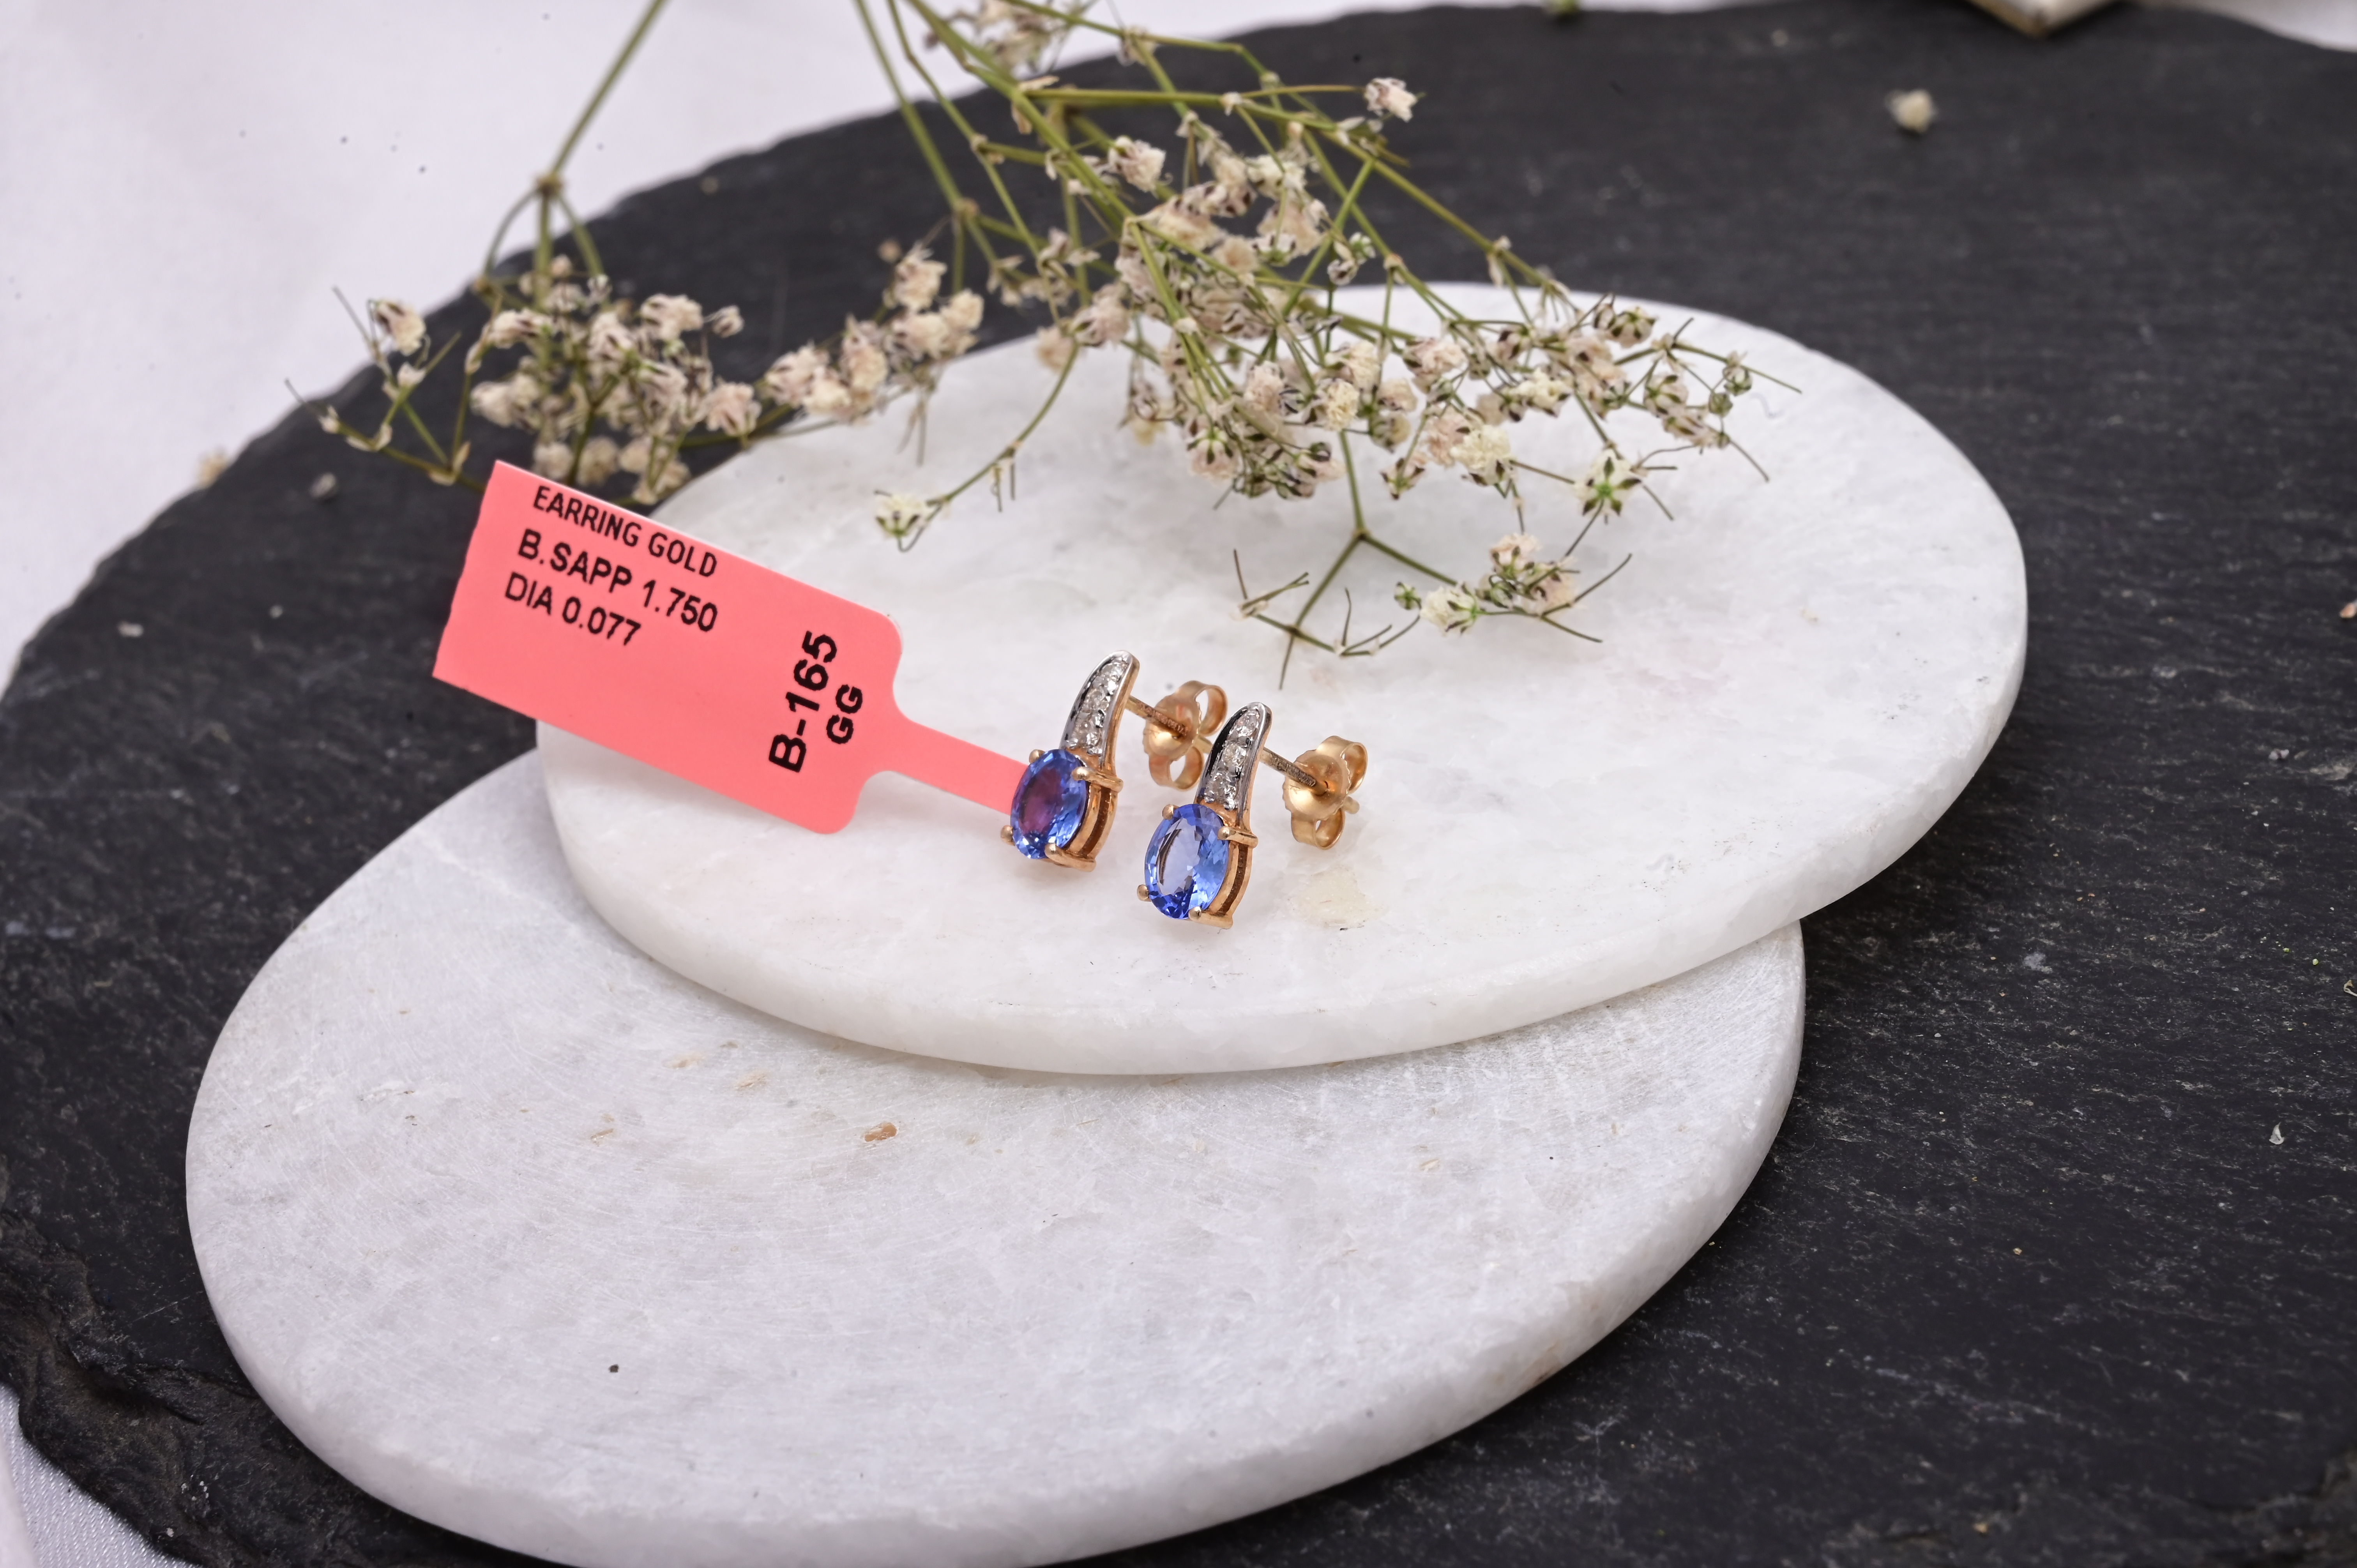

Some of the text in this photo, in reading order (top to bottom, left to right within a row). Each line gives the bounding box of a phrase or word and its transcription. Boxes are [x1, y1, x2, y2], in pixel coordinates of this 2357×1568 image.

[534, 486, 717, 577] EARRING GOLD
[505, 572, 641, 645] DIA 0.077
[518, 529, 718, 632] B.SAPP 1.750
[769, 631, 837, 773] B-165
[826, 684, 863, 745] GG
